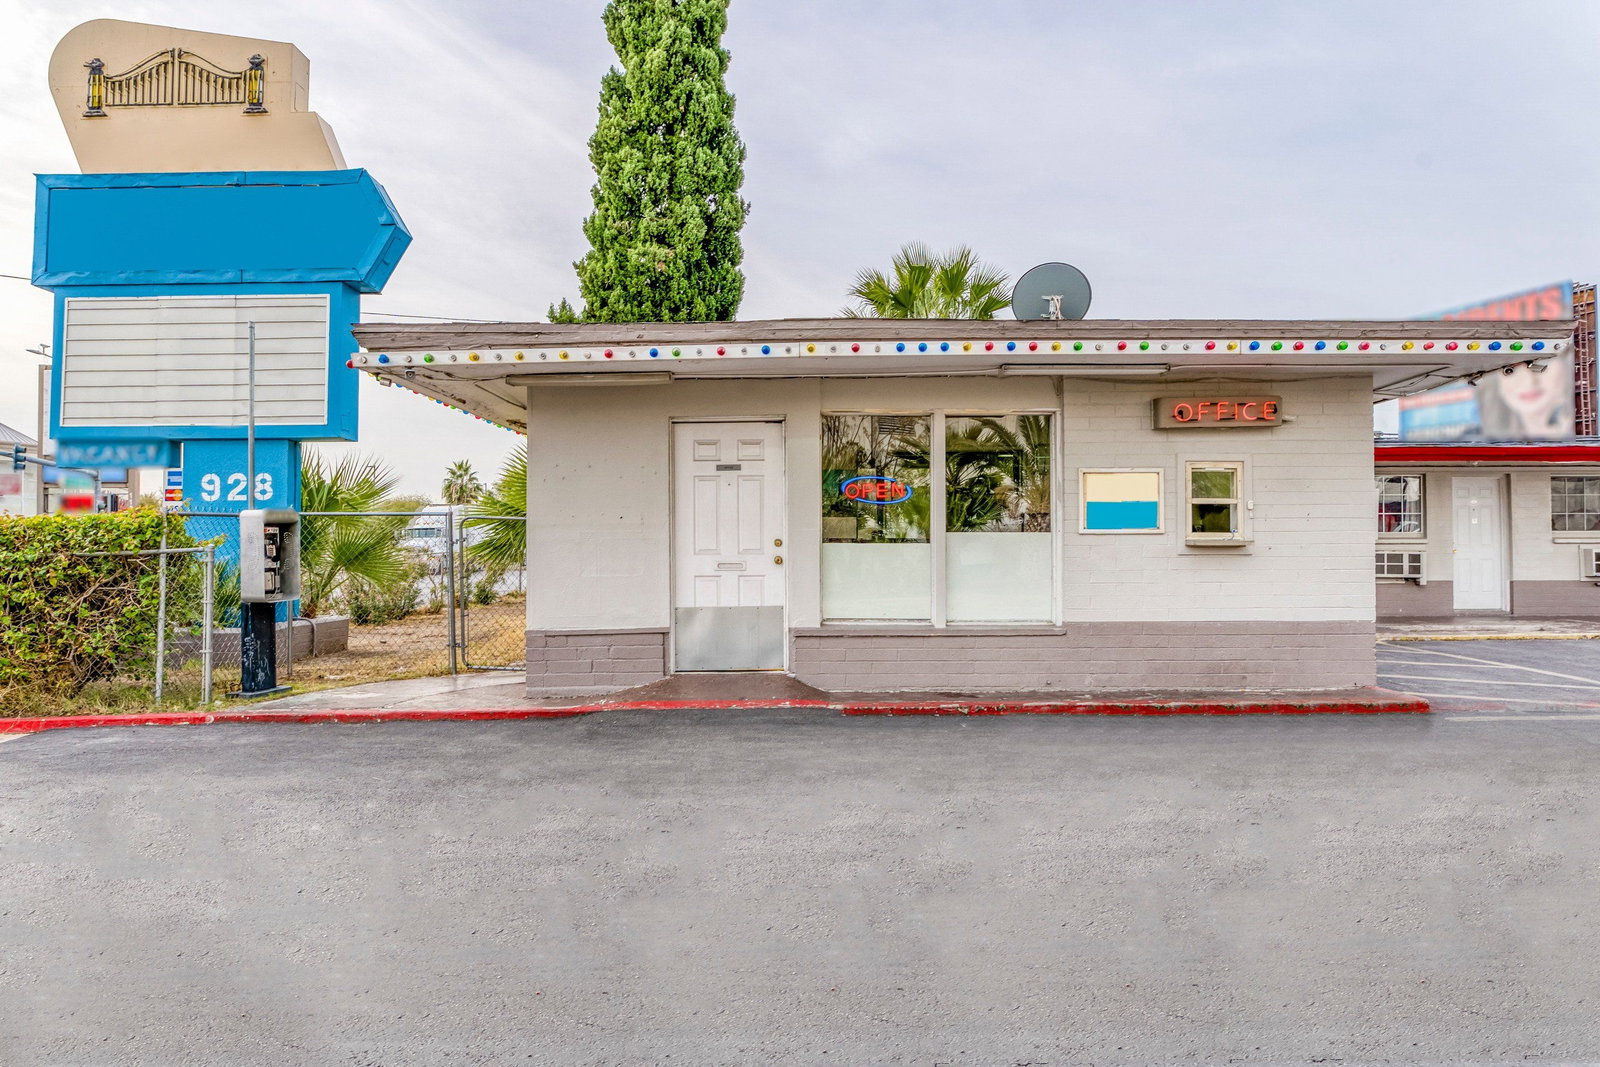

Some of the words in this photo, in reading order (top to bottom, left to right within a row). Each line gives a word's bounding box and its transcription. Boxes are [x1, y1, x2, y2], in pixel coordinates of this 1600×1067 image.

[1174, 401, 1276, 422] OFFICE
[201, 472, 274, 502] 928
[845, 482, 905, 499] OPEN
